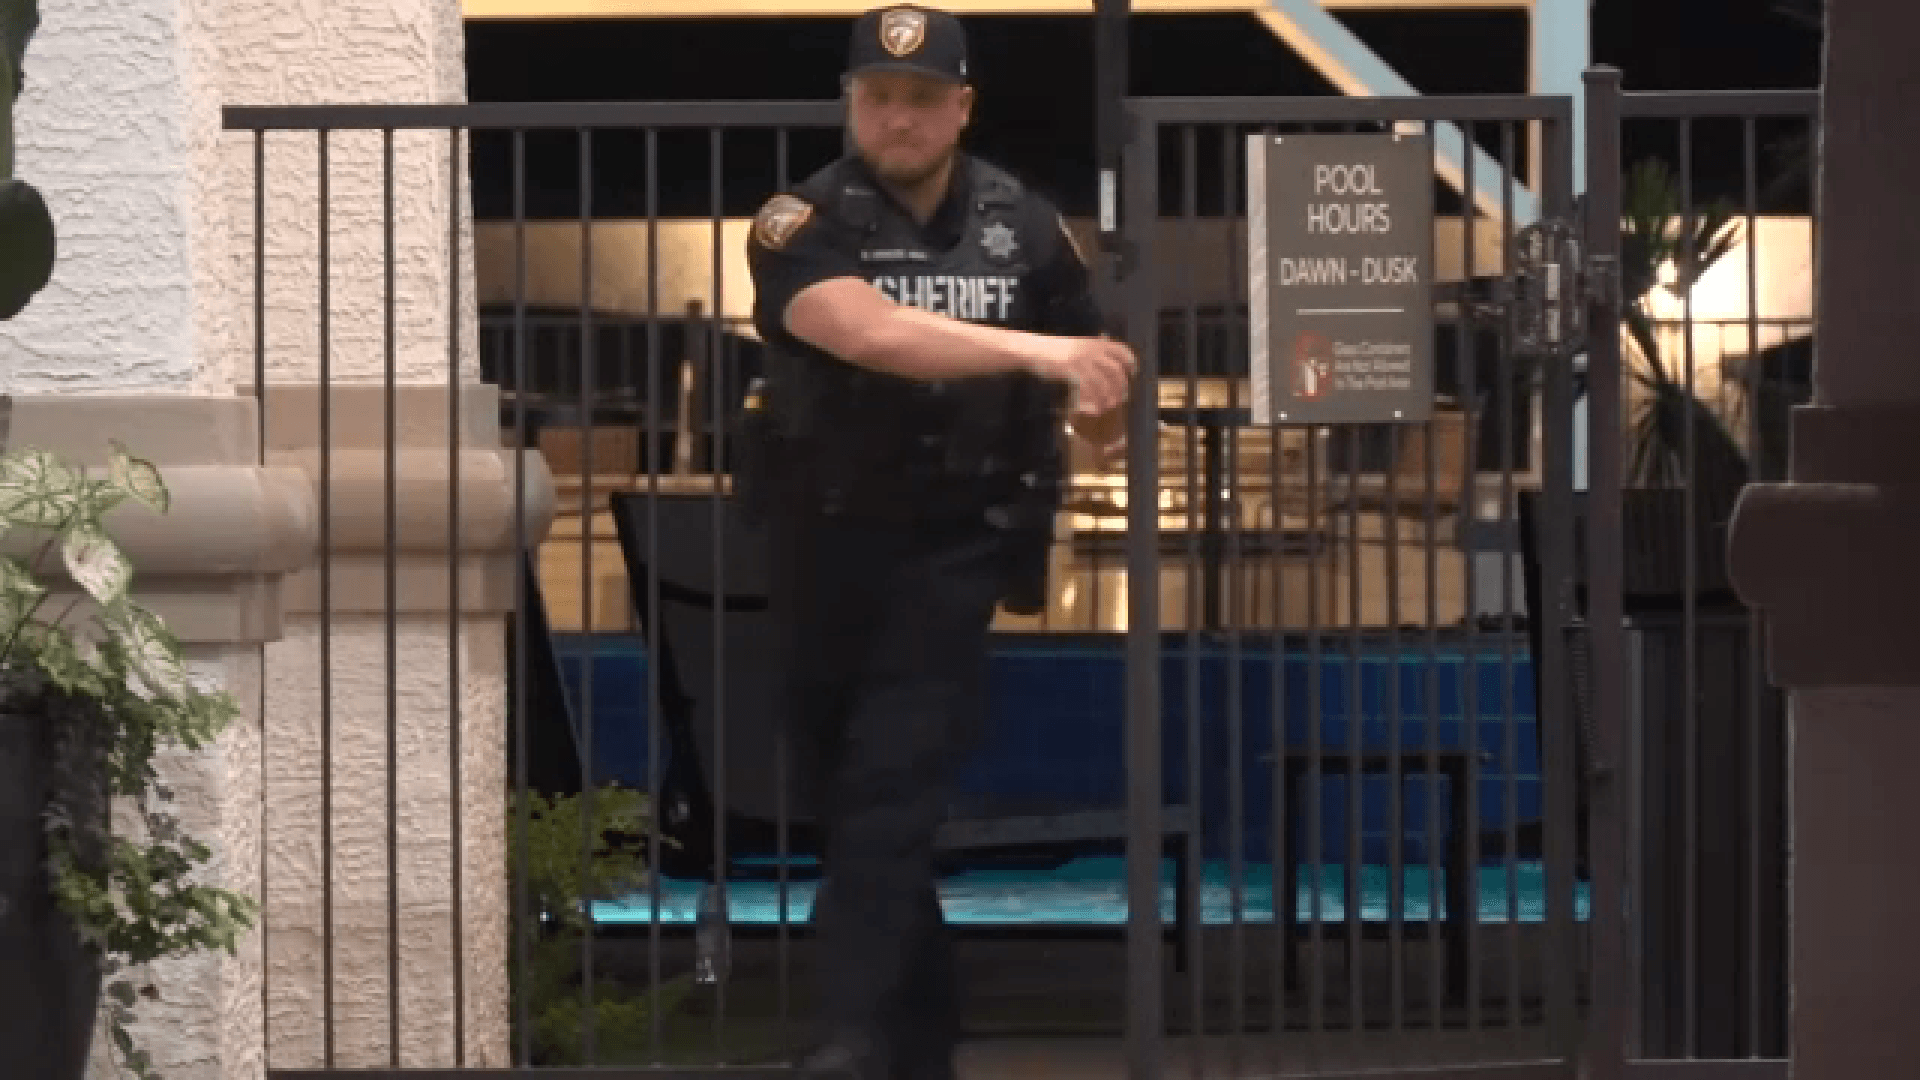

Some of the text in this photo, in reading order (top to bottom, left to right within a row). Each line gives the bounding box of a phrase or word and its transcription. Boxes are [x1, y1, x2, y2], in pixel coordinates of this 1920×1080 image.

[1314, 164, 1383, 195] POOL
[1307, 203, 1390, 234] HOURS
[1280, 257, 1347, 285] DAWN
[1361, 256, 1419, 284] DUSK
